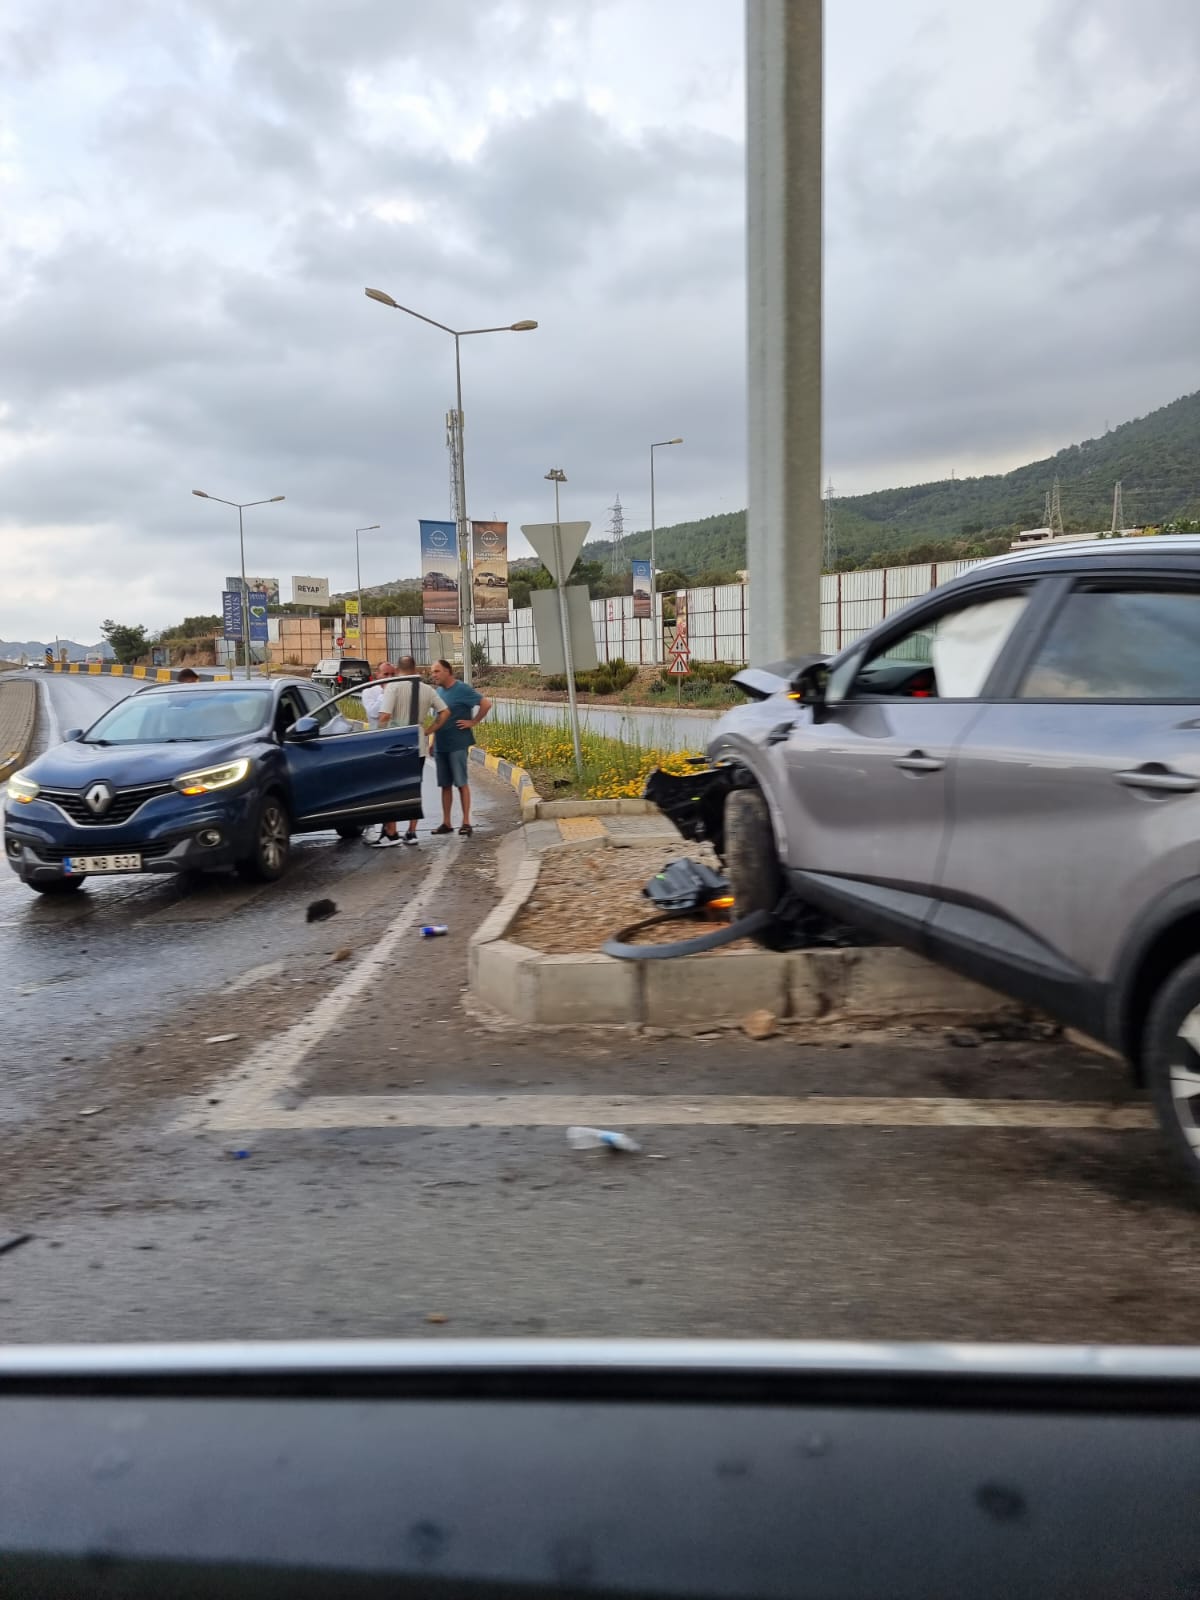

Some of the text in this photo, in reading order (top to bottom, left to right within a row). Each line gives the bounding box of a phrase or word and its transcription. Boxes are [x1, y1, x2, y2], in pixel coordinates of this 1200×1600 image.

[297, 585, 320, 593] REYAP
[224, 594, 233, 632] ARMADA
[232, 595, 241, 630] PRAXIS
